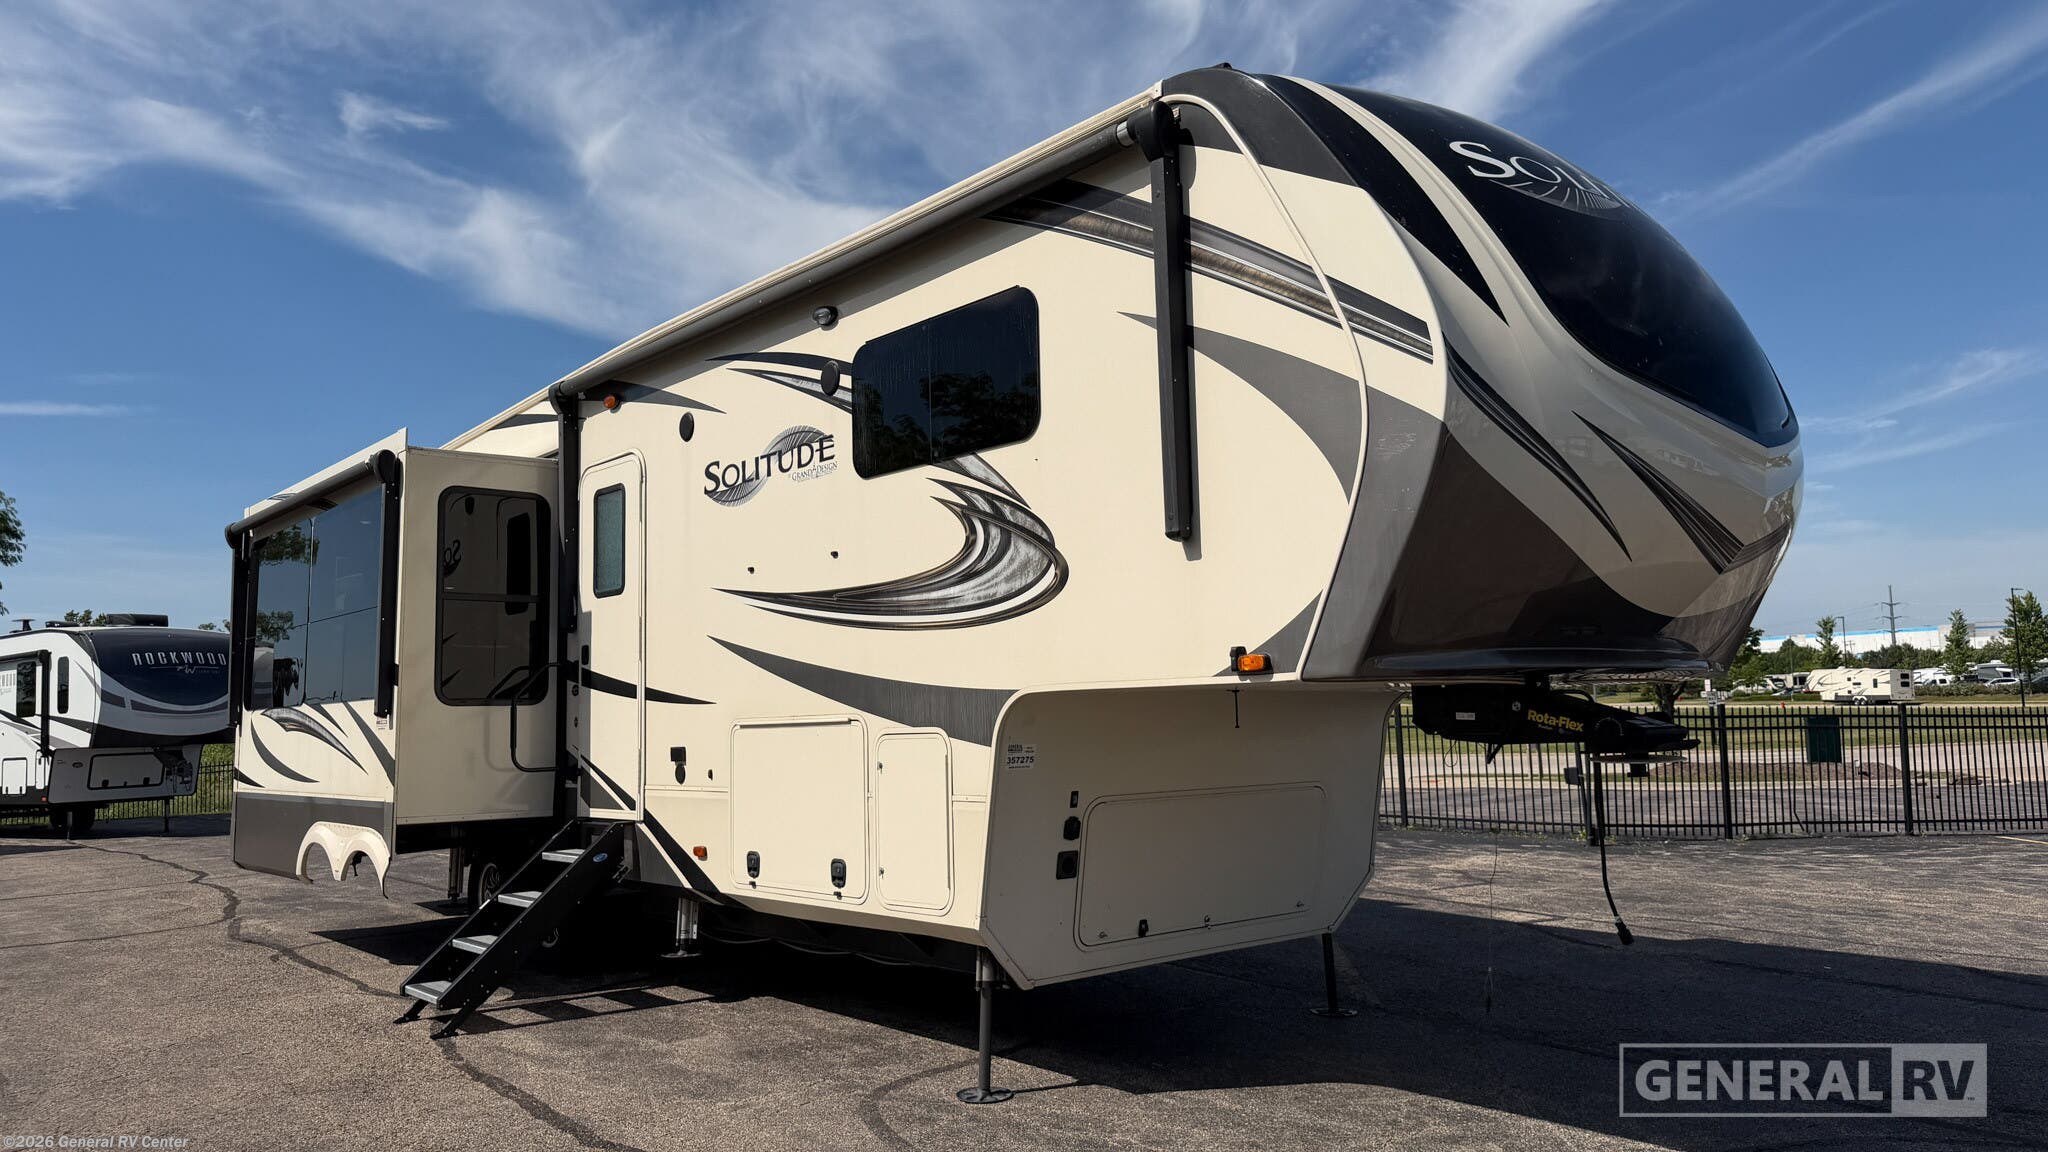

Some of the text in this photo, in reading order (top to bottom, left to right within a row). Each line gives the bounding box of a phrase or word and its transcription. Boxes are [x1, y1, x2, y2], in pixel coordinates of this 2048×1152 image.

[704, 434, 835, 494] SOLITUDE
[131, 651, 227, 666] ROCKWOOD
[1007, 756, 1034, 764] 357275
